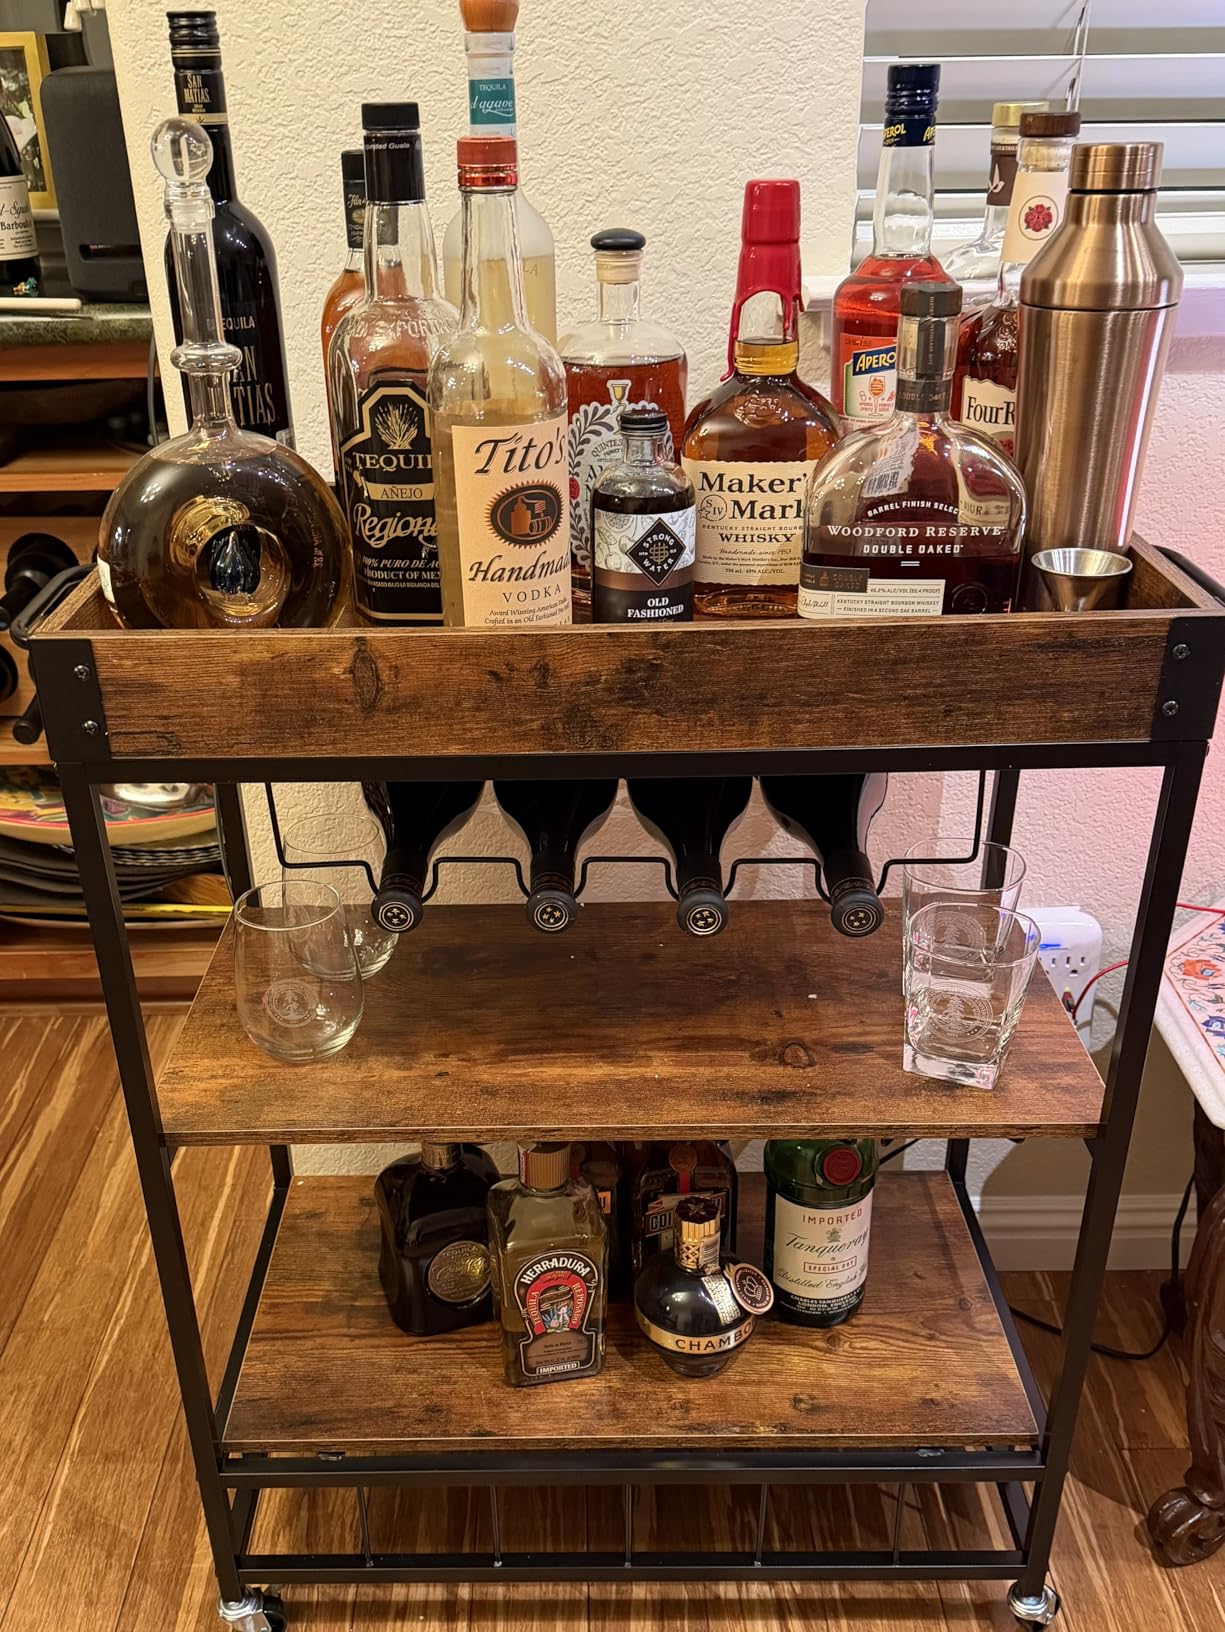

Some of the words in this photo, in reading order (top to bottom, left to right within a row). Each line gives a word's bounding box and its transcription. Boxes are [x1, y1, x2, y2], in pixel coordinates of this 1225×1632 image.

[187, 72, 202, 88] SAN
[184, 87, 209, 103] MATIAS
[966, 395, 1004, 424] Four
[474, 426, 566, 476] Tito's
[380, 486, 423, 499] AÑEJO
[712, 507, 724, 515] IV
[867, 503, 900, 518] BARREL
[902, 500, 932, 509] FINISH
[718, 533, 797, 543] WHISKY
[827, 525, 919, 538] WOODFORD
[925, 525, 1002, 537] RESERVE
[643, 533, 675, 549] STRONG
[863, 544, 913, 554] DOUBLE
[918, 544, 961, 554] OAKED
[380, 559, 410, 568] PURO
[410, 559, 427, 568] DE
[643, 558, 674, 573] WATER
[405, 571, 420, 580] OF
[502, 583, 561, 603] VODKA
[647, 597, 669, 607] OLD
[627, 604, 684, 618] FASHIONED
[802, 1208, 862, 1224] IMPORTED
[785, 1226, 869, 1258] Tanqueray
[520, 1257, 591, 1285] HERRADURA
[528, 1291, 541, 1325] TEQUILA
[572, 1282, 585, 1324] REPOSADO
[539, 1362, 578, 1374] IMPORTED
